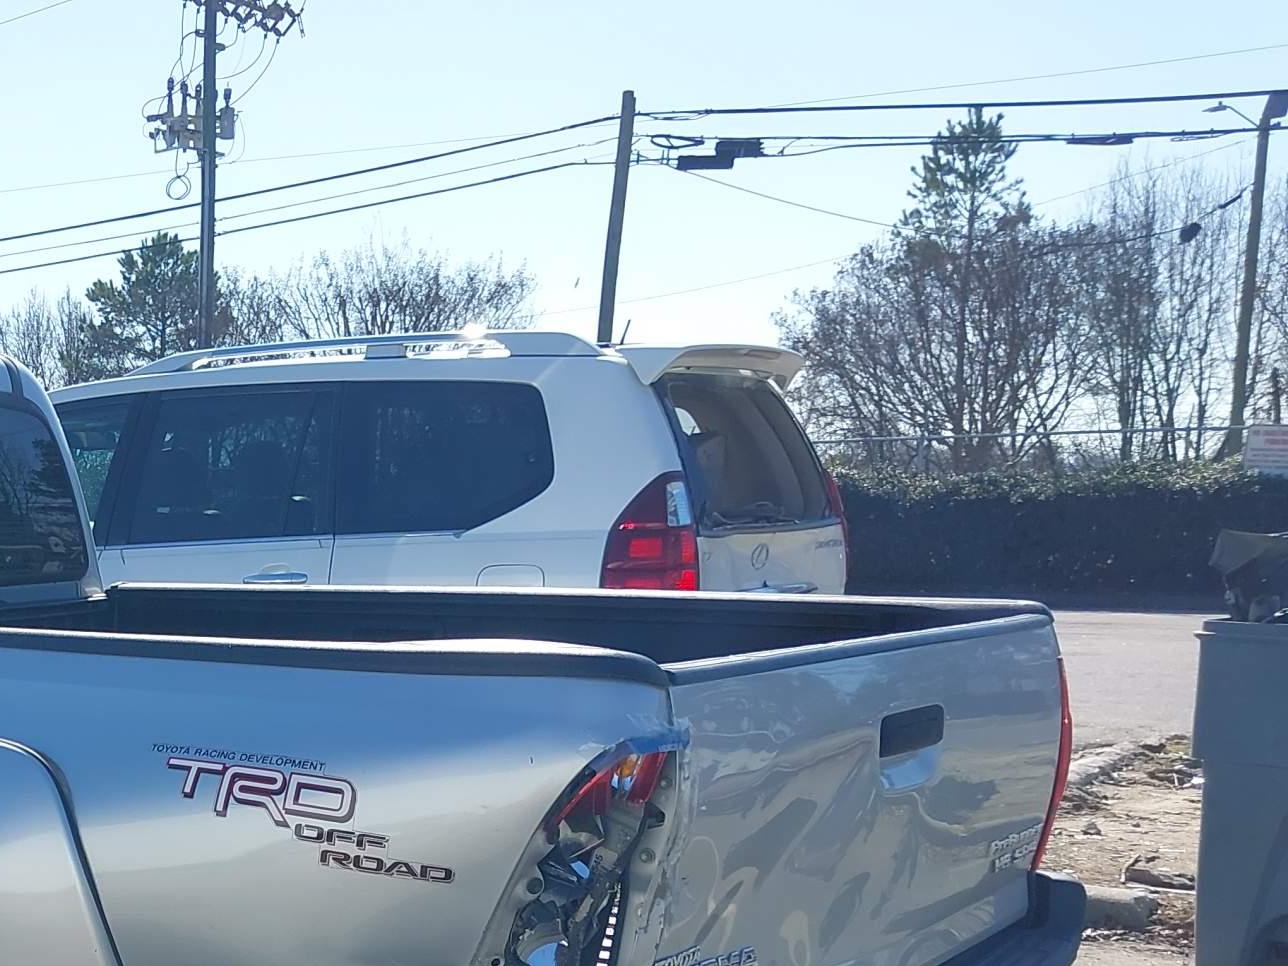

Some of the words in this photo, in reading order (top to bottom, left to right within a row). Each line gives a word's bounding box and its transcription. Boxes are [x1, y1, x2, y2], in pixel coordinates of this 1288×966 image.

[152, 743, 190, 755] TOYOTA
[193, 747, 236, 761] RACING
[238, 751, 326, 772] DEVELOPMENT
[167, 756, 357, 829] TRD
[293, 822, 390, 850] OFF
[319, 849, 456, 883] ROAD
